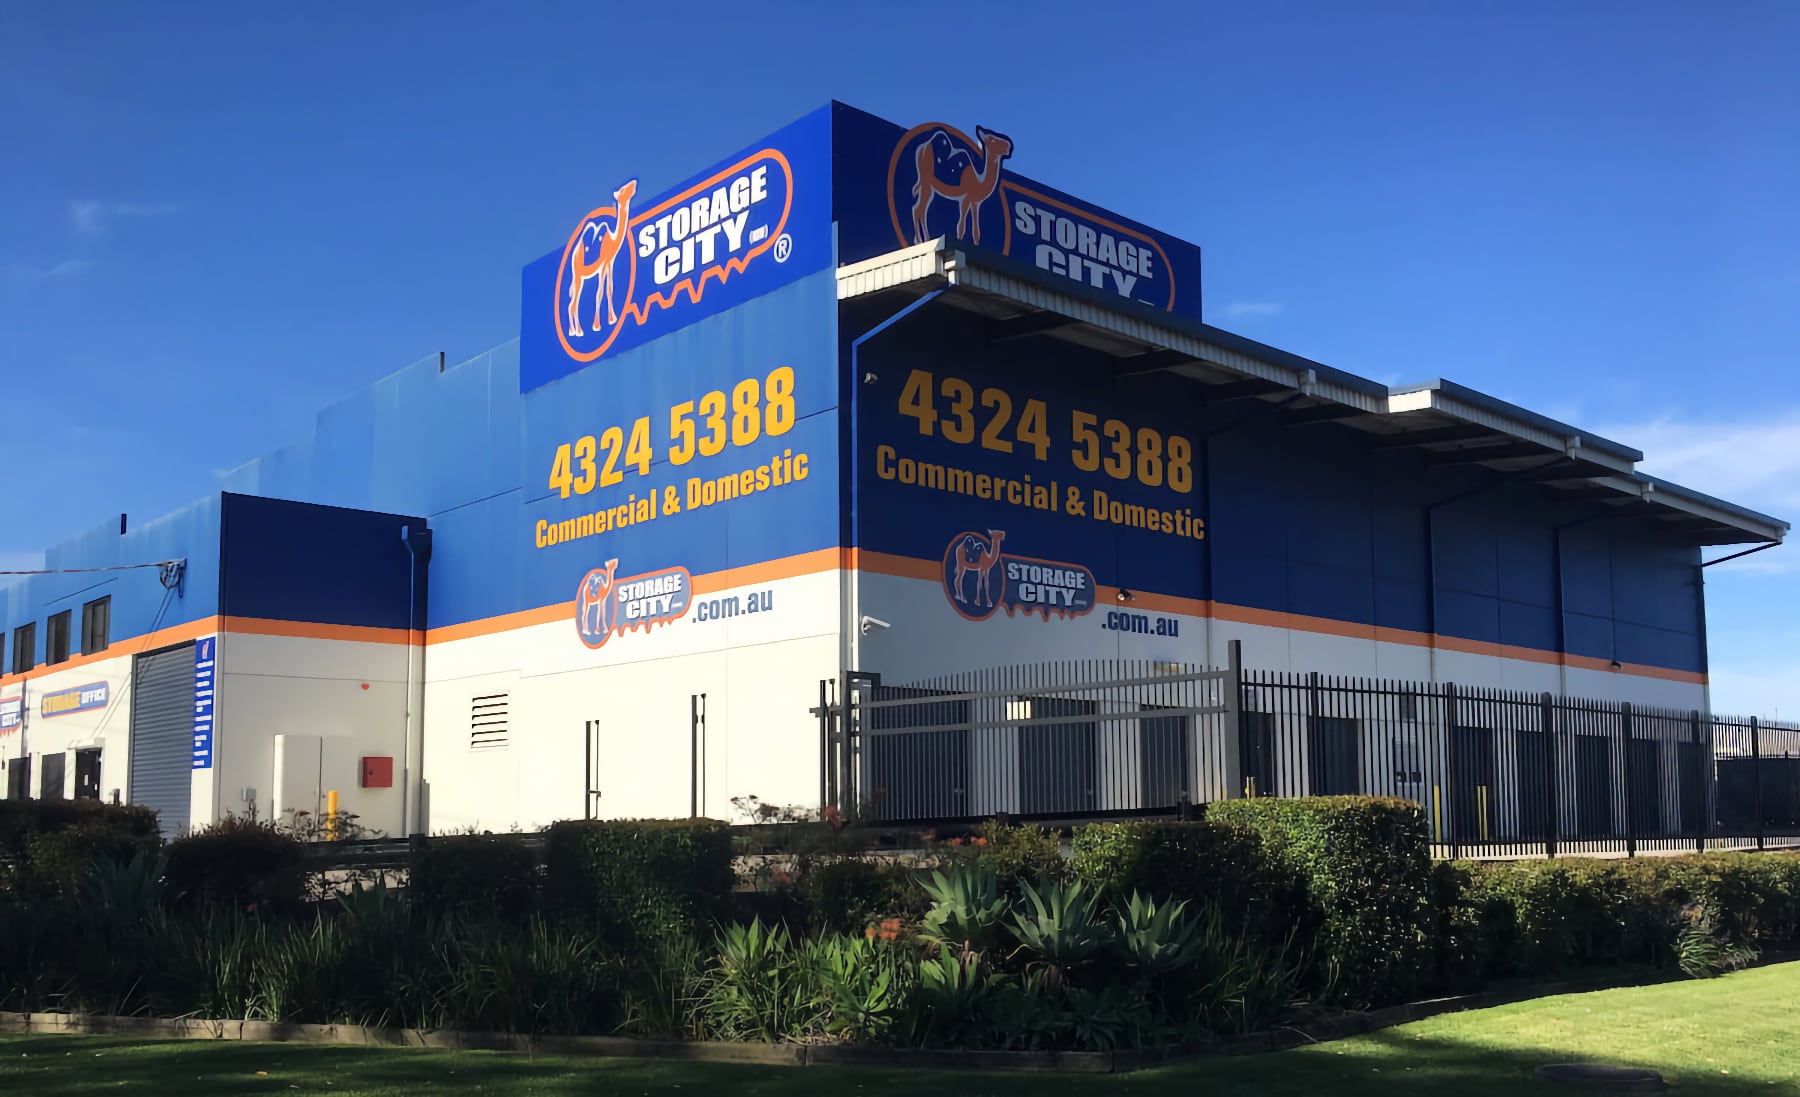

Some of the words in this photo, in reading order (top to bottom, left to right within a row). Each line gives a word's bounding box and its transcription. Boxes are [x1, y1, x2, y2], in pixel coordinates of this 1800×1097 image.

[638, 165, 767, 258] STORAGE
[1015, 201, 1153, 279] STORAGE
[653, 209, 750, 285] CITY
[1035, 244, 1137, 299] CITY
[549, 416, 653, 499] 4324
[669, 366, 795, 466] 5388
[898, 369, 1051, 461] 4324
[1071, 410, 1193, 493] 5388
[535, 490, 657, 549] Commercial
[662, 485, 681, 516] &
[687, 449, 809, 510] Domestic
[876, 445, 1058, 512] Commercial
[1065, 486, 1086, 516] &
[1093, 489, 1205, 540] Domestic
[618, 573, 683, 603] STORAGE
[626, 594, 673, 619] CITY
[692, 589, 773, 623] .com.au
[1007, 562, 1086, 589] STORAGE
[1018, 583, 1076, 606] CITY
[1101, 611, 1179, 637] .com.au
